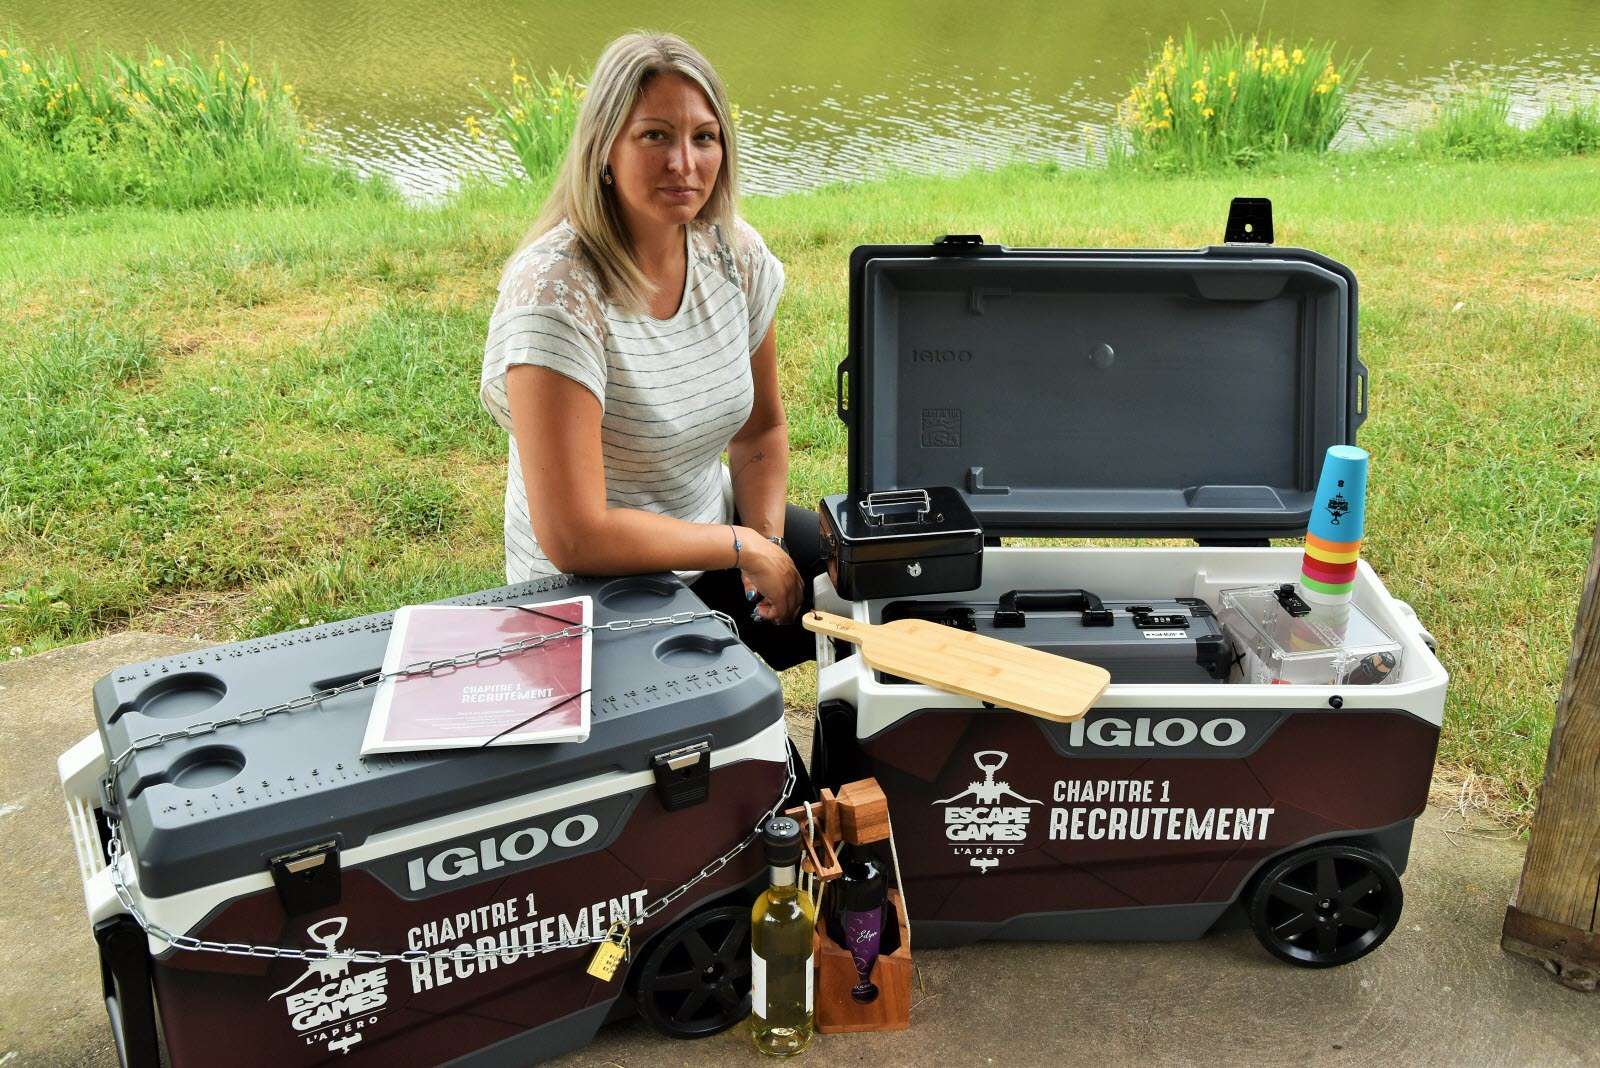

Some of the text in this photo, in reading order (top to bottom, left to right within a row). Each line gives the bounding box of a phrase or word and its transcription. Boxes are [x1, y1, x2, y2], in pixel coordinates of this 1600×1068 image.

[911, 349, 973, 362] IGLOO
[461, 687, 554, 704] RECRUTEMENT
[462, 683, 513, 694] CHAPITRE
[1069, 717, 1246, 747] IGLOO
[1053, 780, 1170, 802] CHAPITRE 1
[944, 807, 1031, 824] ESCAPE
[1049, 808, 1275, 840] RECRUTEMENT
[945, 823, 1027, 841] GAMES
[407, 814, 599, 891] IGLOO
[407, 893, 538, 951] CHAPITRE 1
[410, 889, 648, 994] RECRUTEMENT
[286, 967, 388, 1016] ESCAPE
[292, 987, 388, 1031] GAMES
